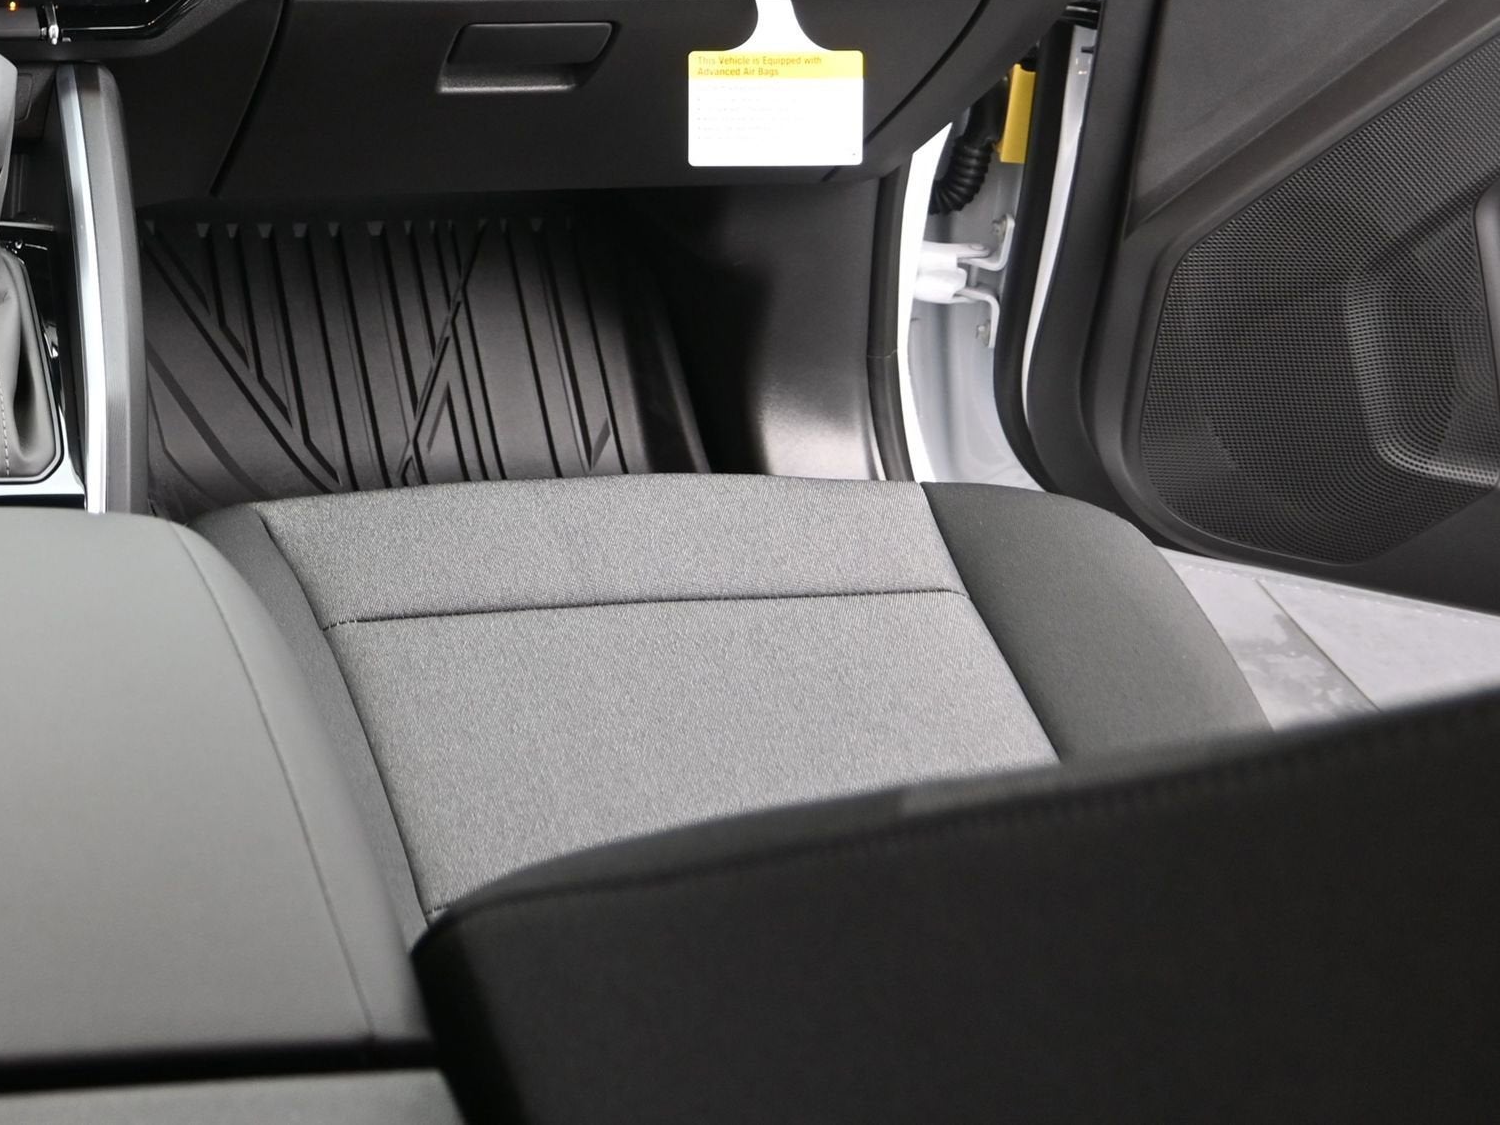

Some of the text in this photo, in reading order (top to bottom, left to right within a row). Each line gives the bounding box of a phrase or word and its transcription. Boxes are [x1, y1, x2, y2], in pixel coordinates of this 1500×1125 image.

[697, 55, 822, 68] This Vehicle is Equipped with
[697, 66, 780, 79] Advanced Air Bags
